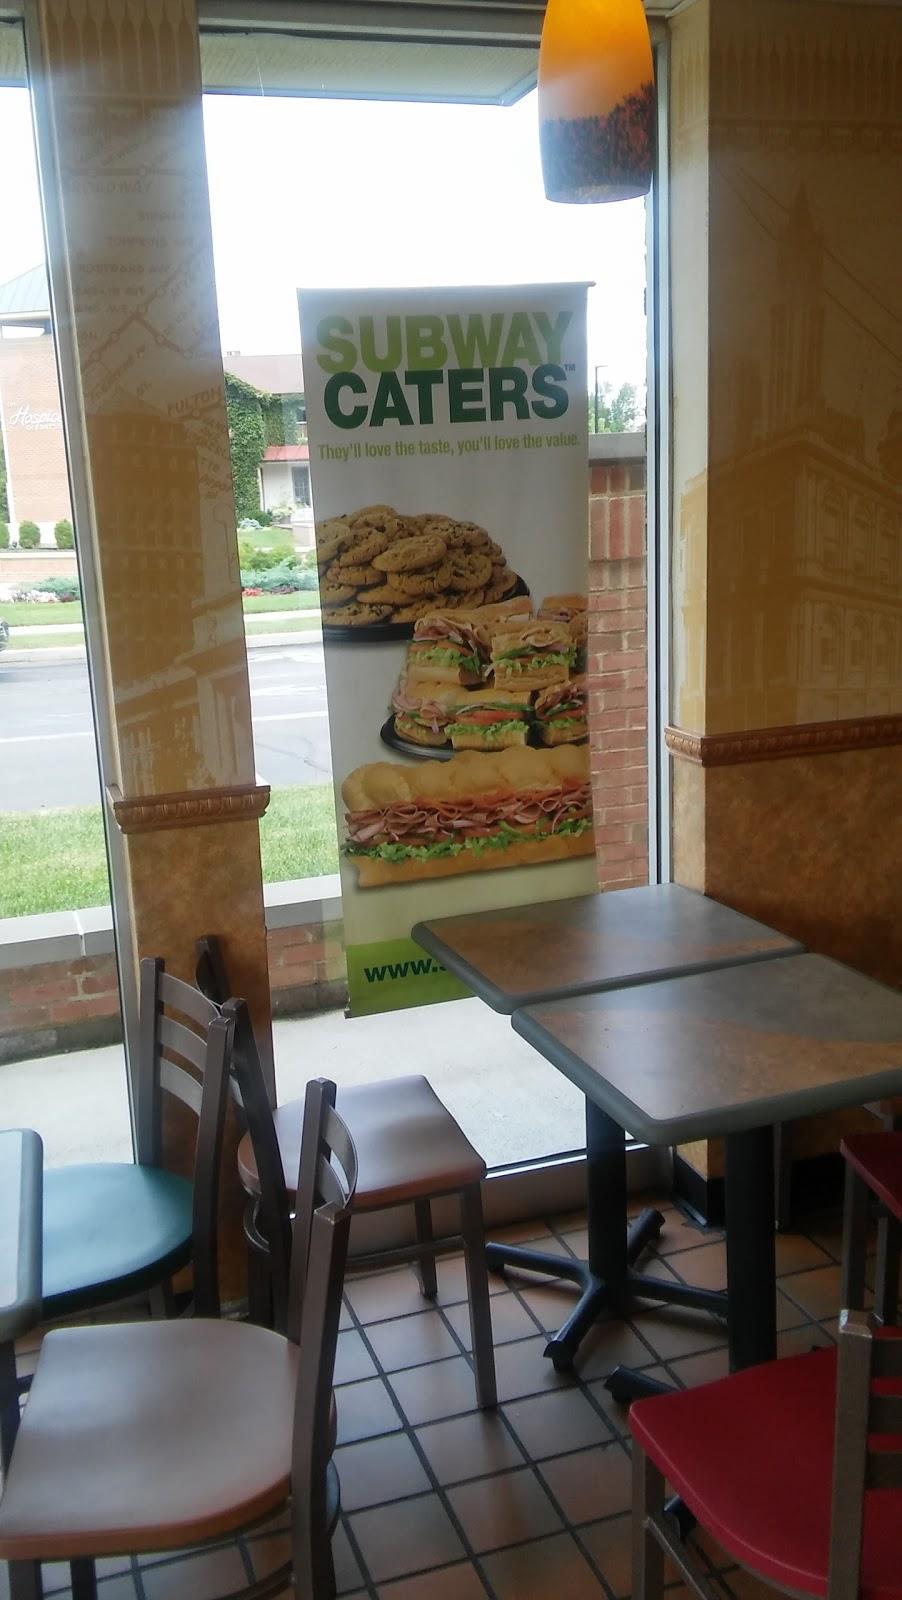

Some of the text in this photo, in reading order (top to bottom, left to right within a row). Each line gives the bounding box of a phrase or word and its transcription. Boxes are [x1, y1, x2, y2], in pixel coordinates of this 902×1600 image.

[316, 311, 573, 374] SUBWAY
[167, 385, 222, 417] FULTON
[323, 363, 569, 430] CATERS
[318, 442, 361, 462] They'll
[365, 441, 391, 458] love
[395, 440, 415, 456] the
[419, 439, 454, 456] taste,
[457, 435, 491, 456] you'll
[495, 434, 520, 451] love
[523, 433, 542, 449] the
[363, 958, 447, 983] www.
